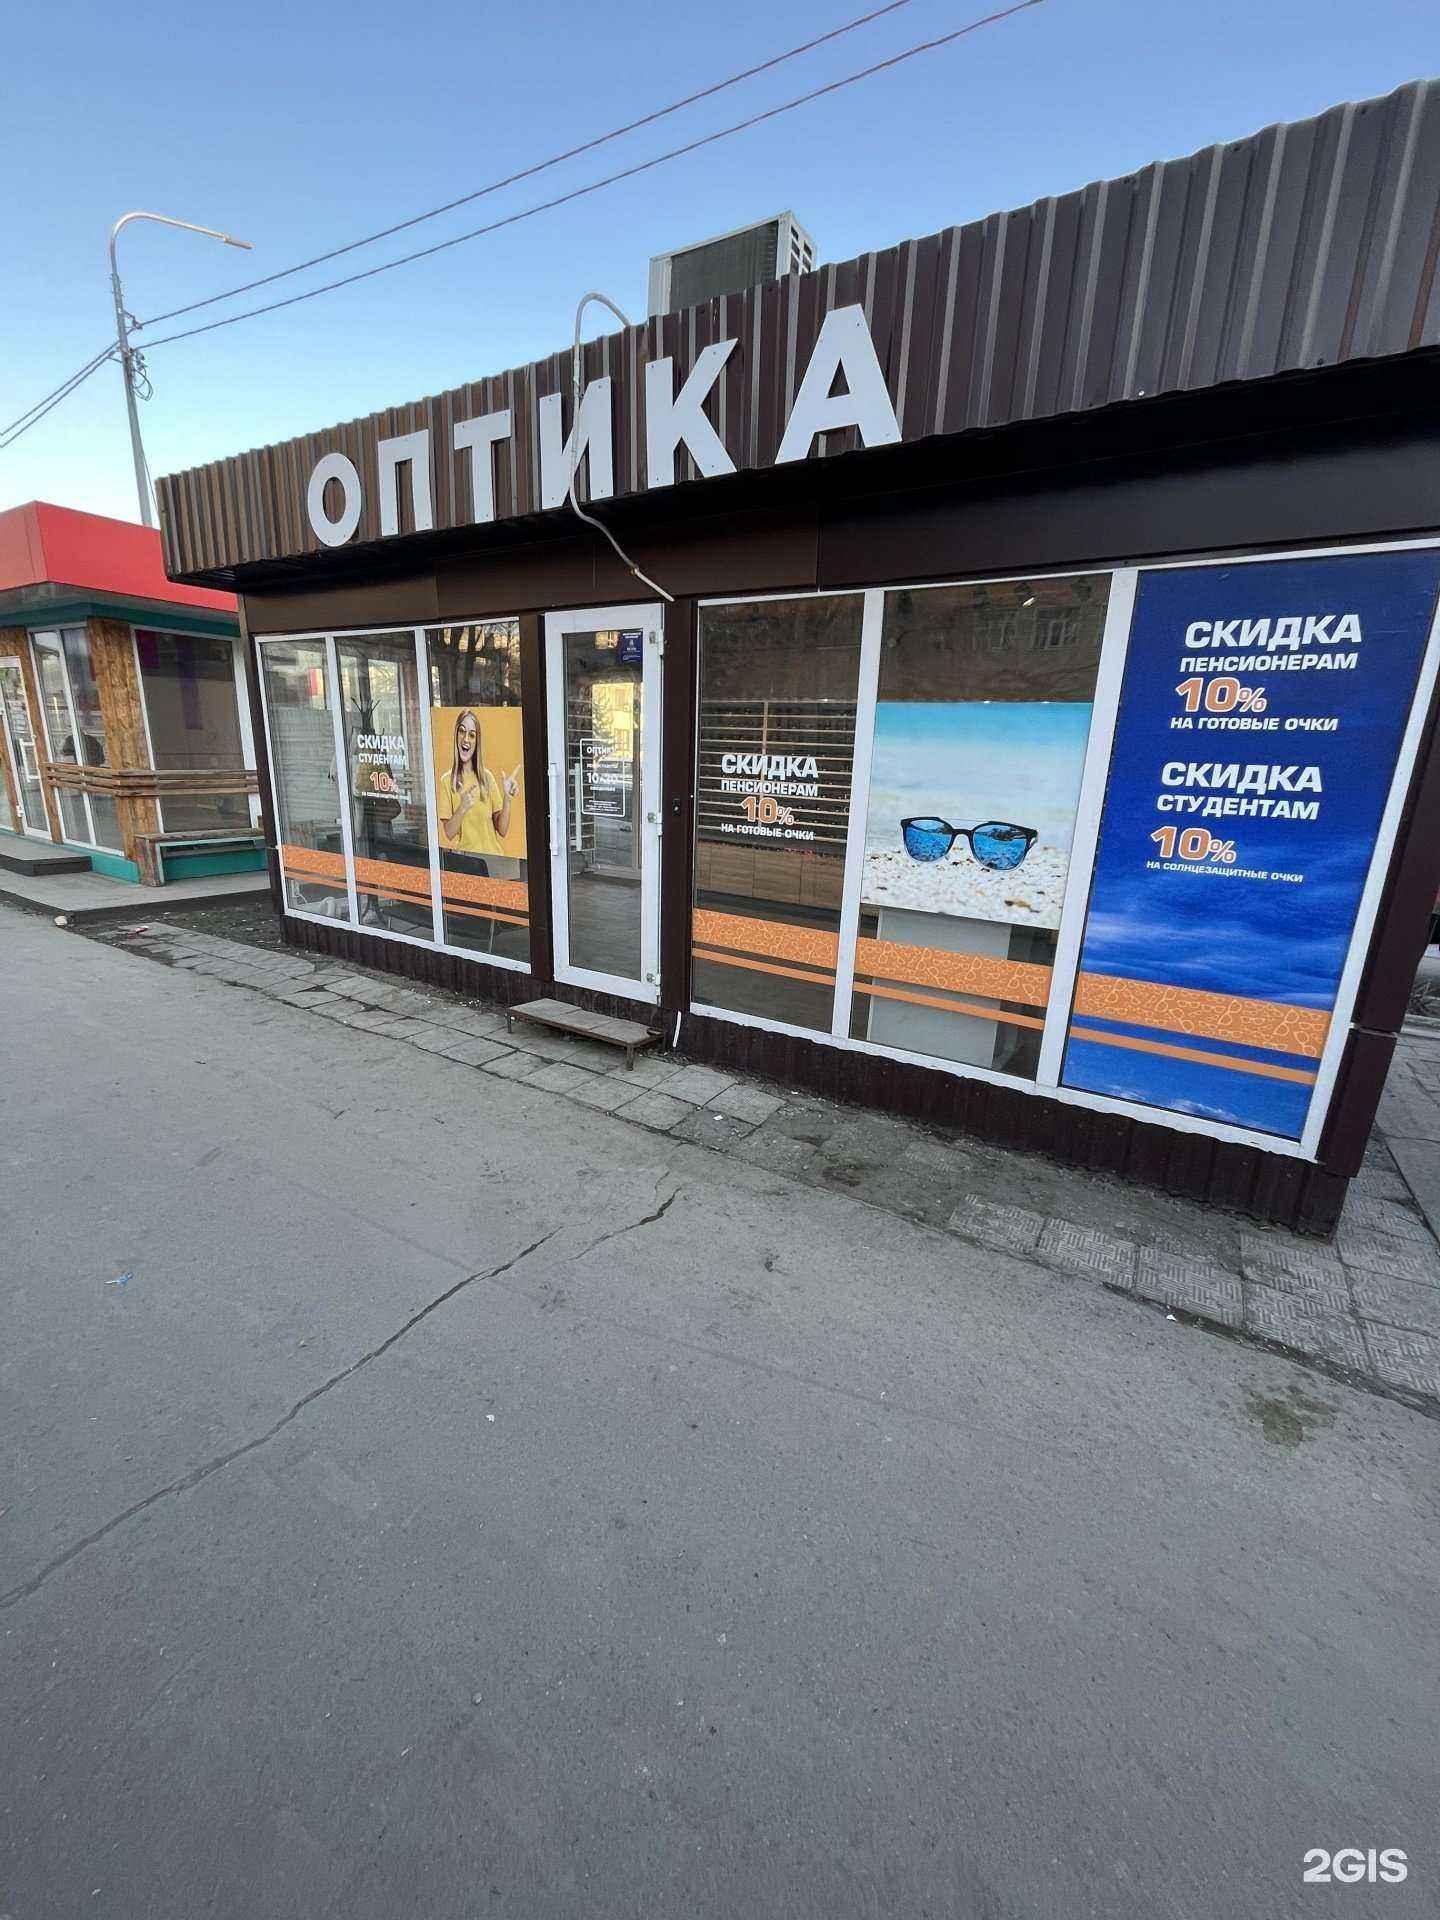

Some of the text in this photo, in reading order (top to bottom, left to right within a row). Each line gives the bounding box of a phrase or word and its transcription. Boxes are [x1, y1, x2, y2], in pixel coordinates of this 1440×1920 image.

[307, 302, 903, 547] ОПТИКА
[1184, 614, 1362, 651] СКИДКА
[1180, 653, 1358, 672] ПЕНСИОНЕРАМ
[1175, 677, 1267, 712] 10%
[1170, 717, 1338, 731] НА ГОТОВЫЕ ОЧКИ
[357, 734, 405, 752] СКИДКА
[721, 754, 819, 781] СКИДКА
[1161, 762, 1323, 794] СКИДКА
[370, 771, 400, 793] 10%
[721, 780, 818, 797] ПЕНСИОНЕРАМ
[741, 796, 795, 826] 10%
[1156, 795, 1319, 820] СТУДЕНТАМ
[721, 823, 815, 841] НА ГОТОВЫЕ ОЧКИ
[1150, 826, 1237, 863] 10%
[1146, 861, 1303, 882] НА СОЛНЦЕЗАЩИТНЫЕ ОЧКИ
